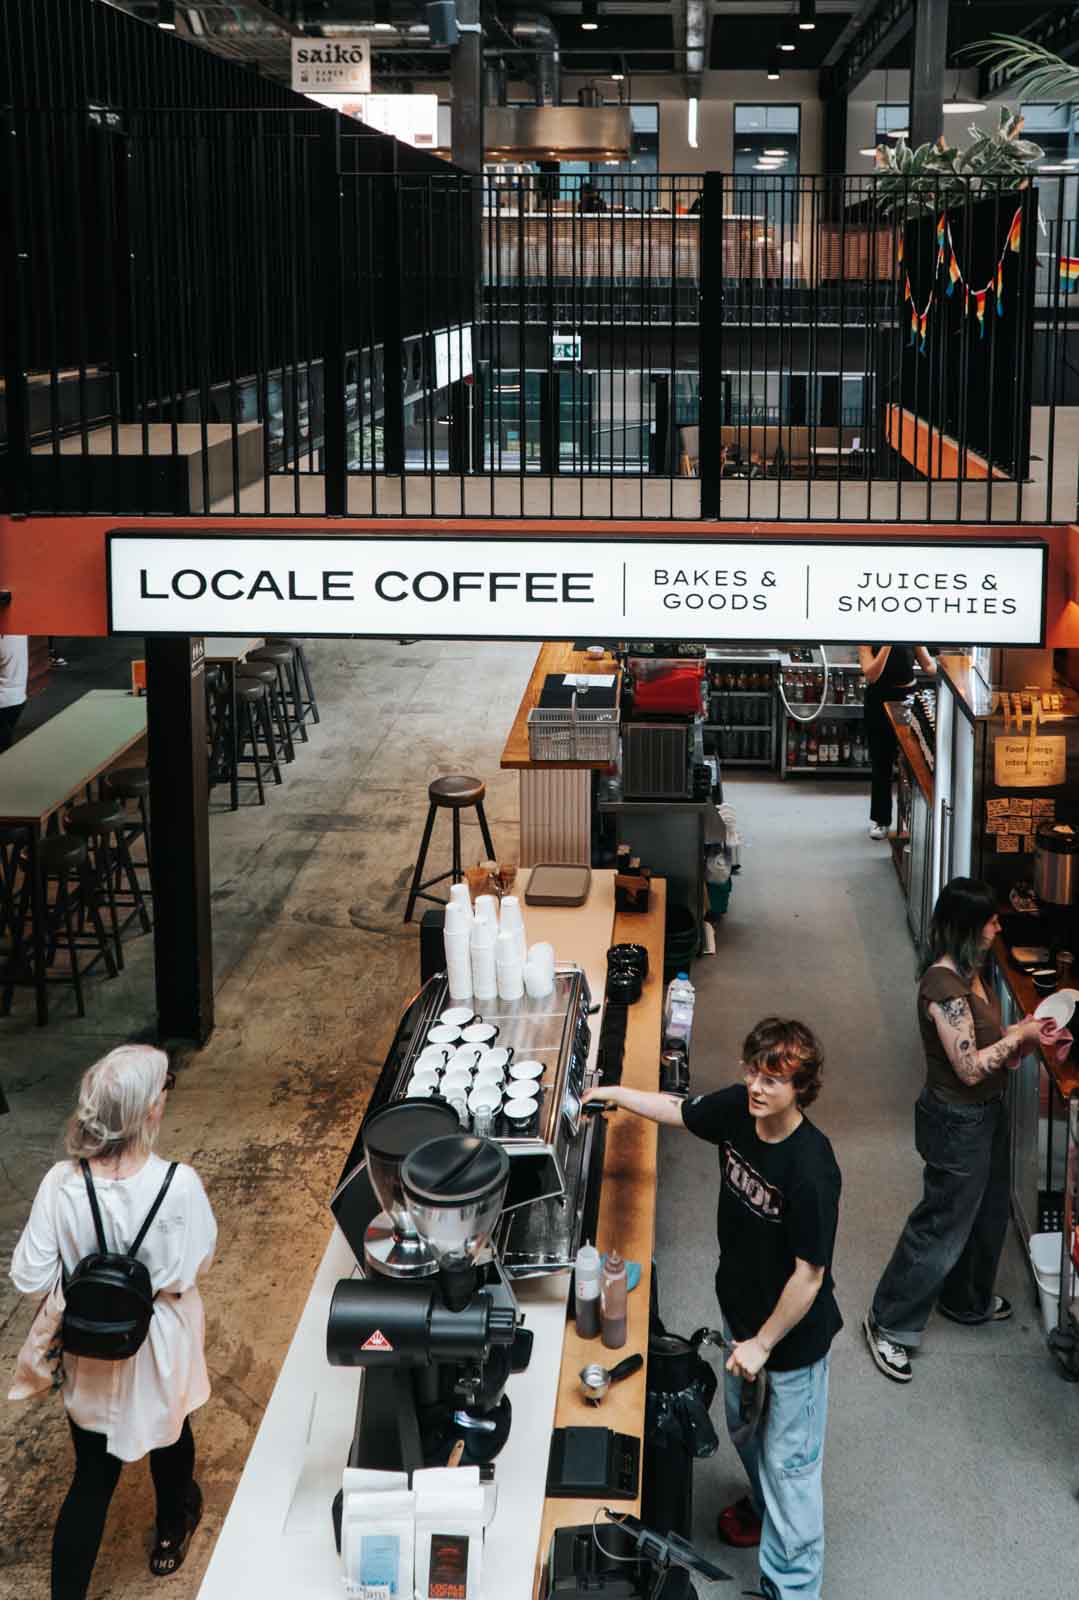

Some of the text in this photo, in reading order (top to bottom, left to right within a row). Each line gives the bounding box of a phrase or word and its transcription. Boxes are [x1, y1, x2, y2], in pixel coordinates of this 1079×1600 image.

[297, 44, 363, 64] saikō
[139, 568, 595, 603] LOCALE COFFEE
[654, 569, 777, 588] BAKES &
[857, 572, 998, 591] JUICES &
[663, 593, 768, 611] GOODS
[837, 596, 1018, 614] SMOOTHIES
